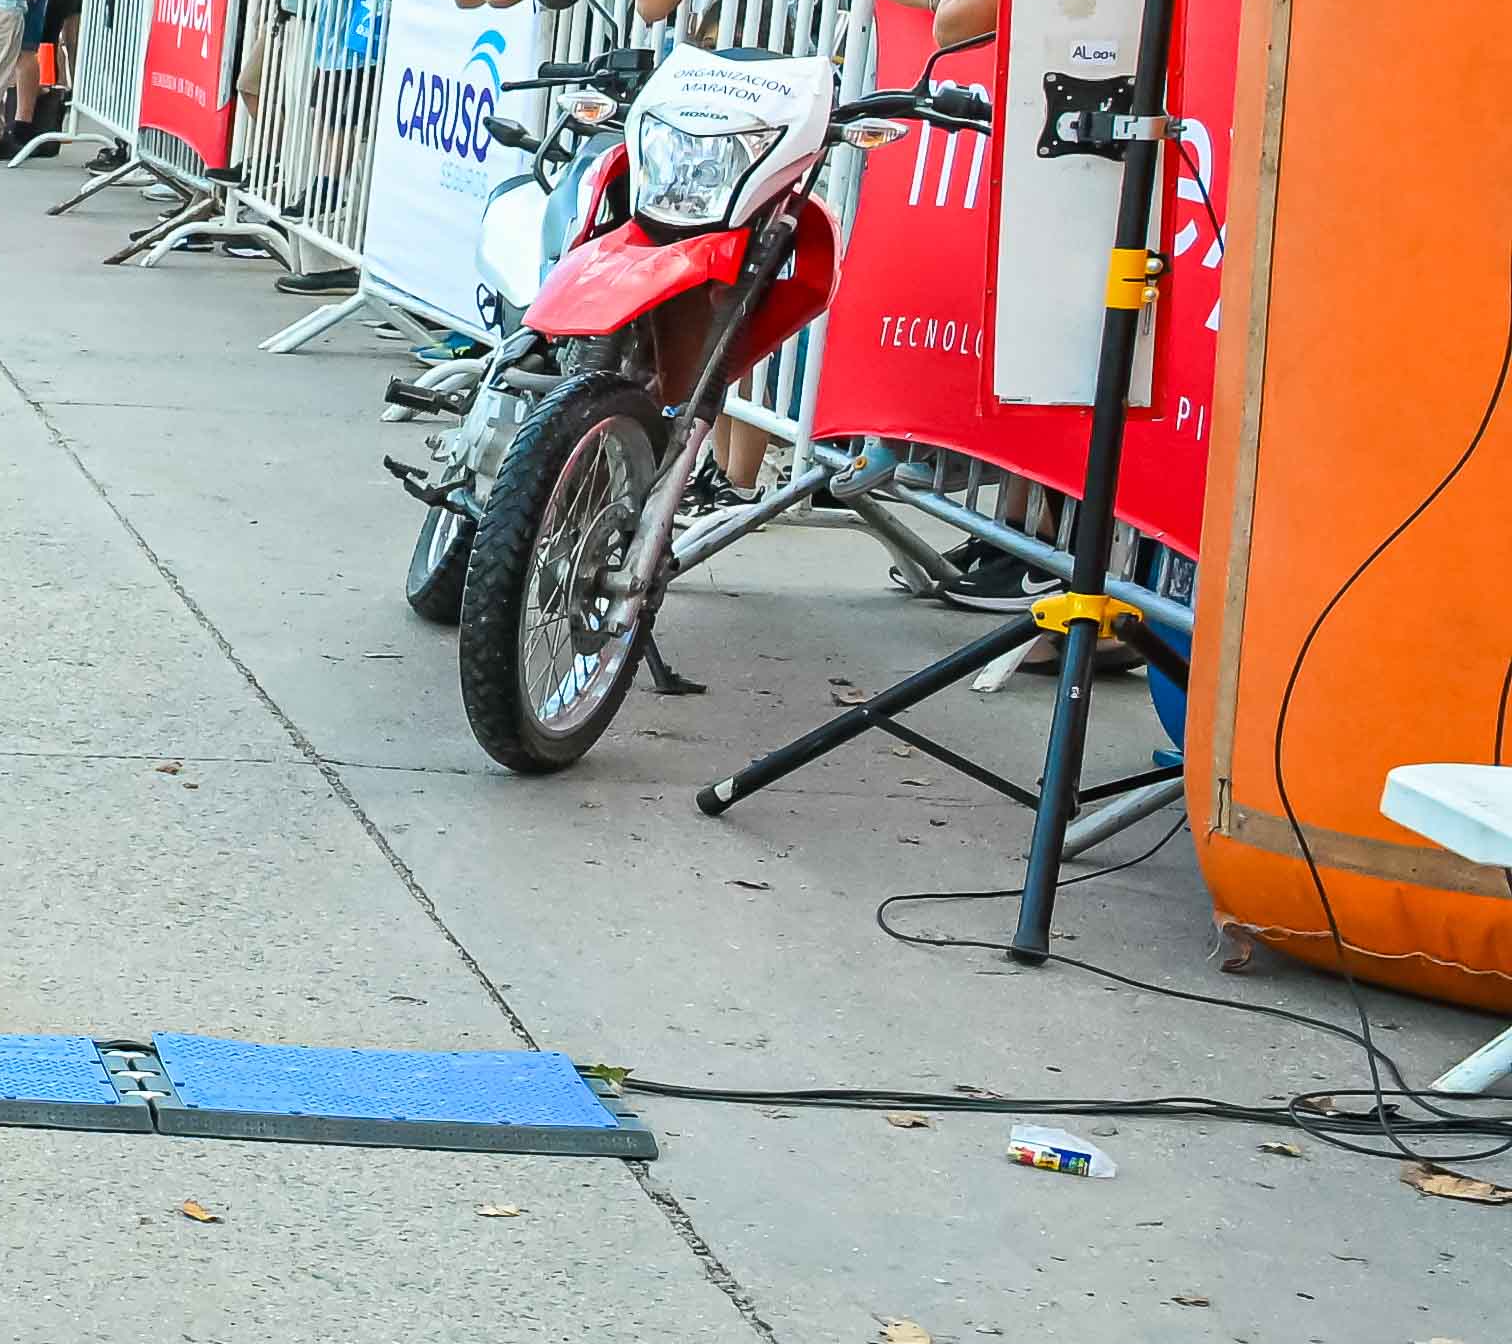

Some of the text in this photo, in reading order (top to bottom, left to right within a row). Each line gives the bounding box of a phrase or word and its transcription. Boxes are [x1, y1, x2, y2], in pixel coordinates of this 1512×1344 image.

[673, 69, 792, 96] ORGANIZACION
[682, 83, 761, 103] MARATON
[396, 67, 495, 163] CARUSO
[679, 111, 729, 120] HONDA
